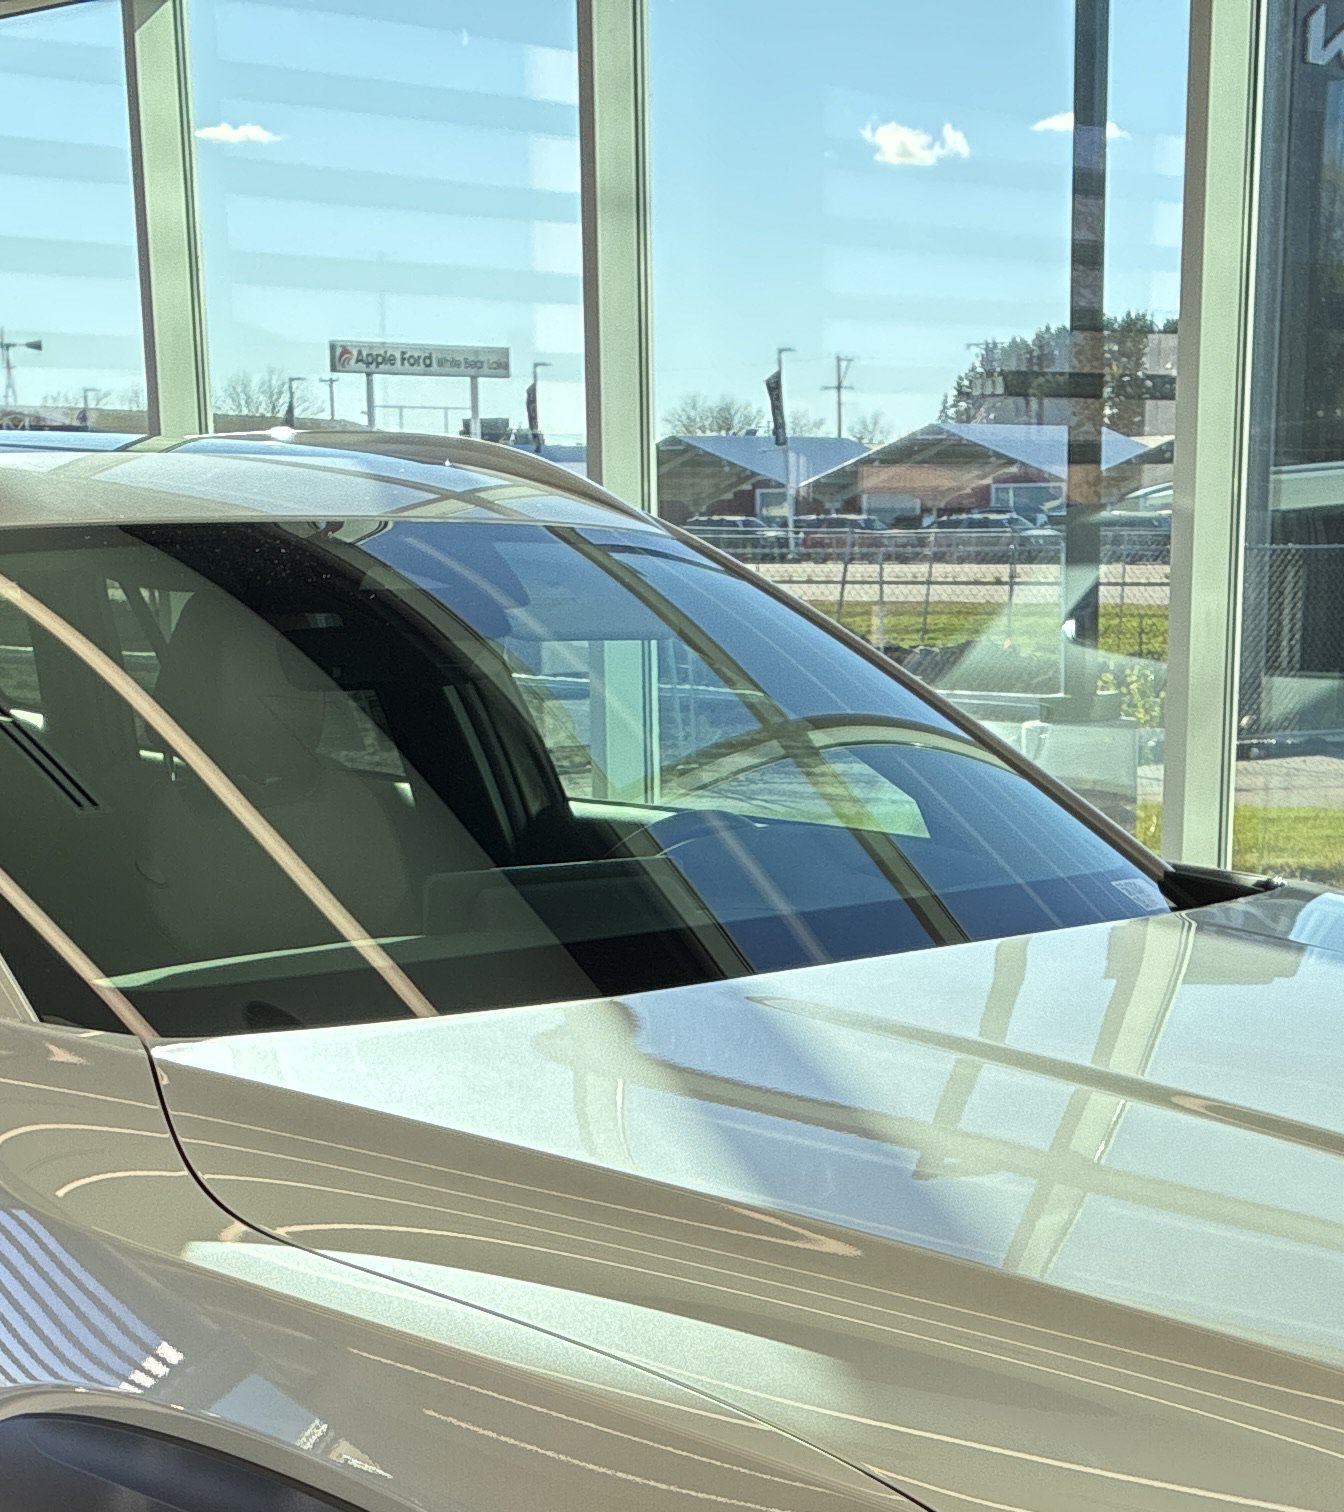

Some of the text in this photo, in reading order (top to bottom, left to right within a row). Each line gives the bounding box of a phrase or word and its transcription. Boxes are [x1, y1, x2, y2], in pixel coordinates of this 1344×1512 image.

[356, 349, 397, 369] Apple
[400, 350, 433, 368] Ford
[463, 357, 485, 370] Bear
